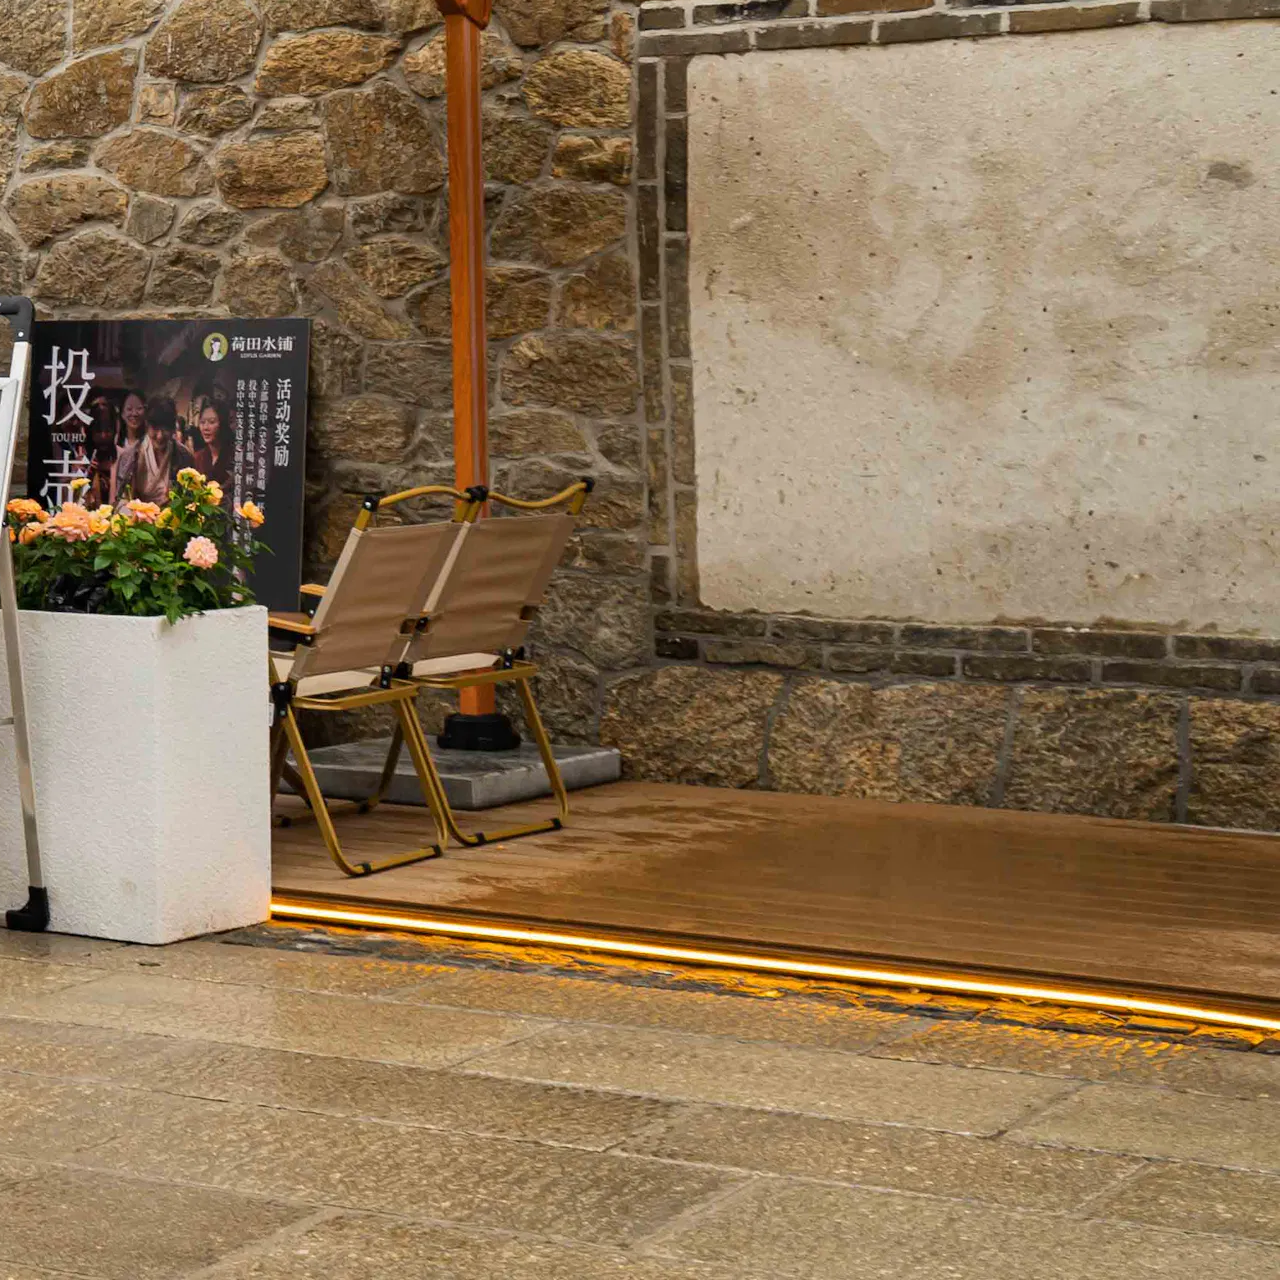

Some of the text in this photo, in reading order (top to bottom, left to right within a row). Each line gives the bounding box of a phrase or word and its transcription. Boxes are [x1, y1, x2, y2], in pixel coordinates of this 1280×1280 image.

[232, 336, 294, 351] 荷田水铺
[41, 345, 96, 426] 投
[51, 433, 86, 443] TOU HU
[274, 378, 292, 467] 活动奖励
